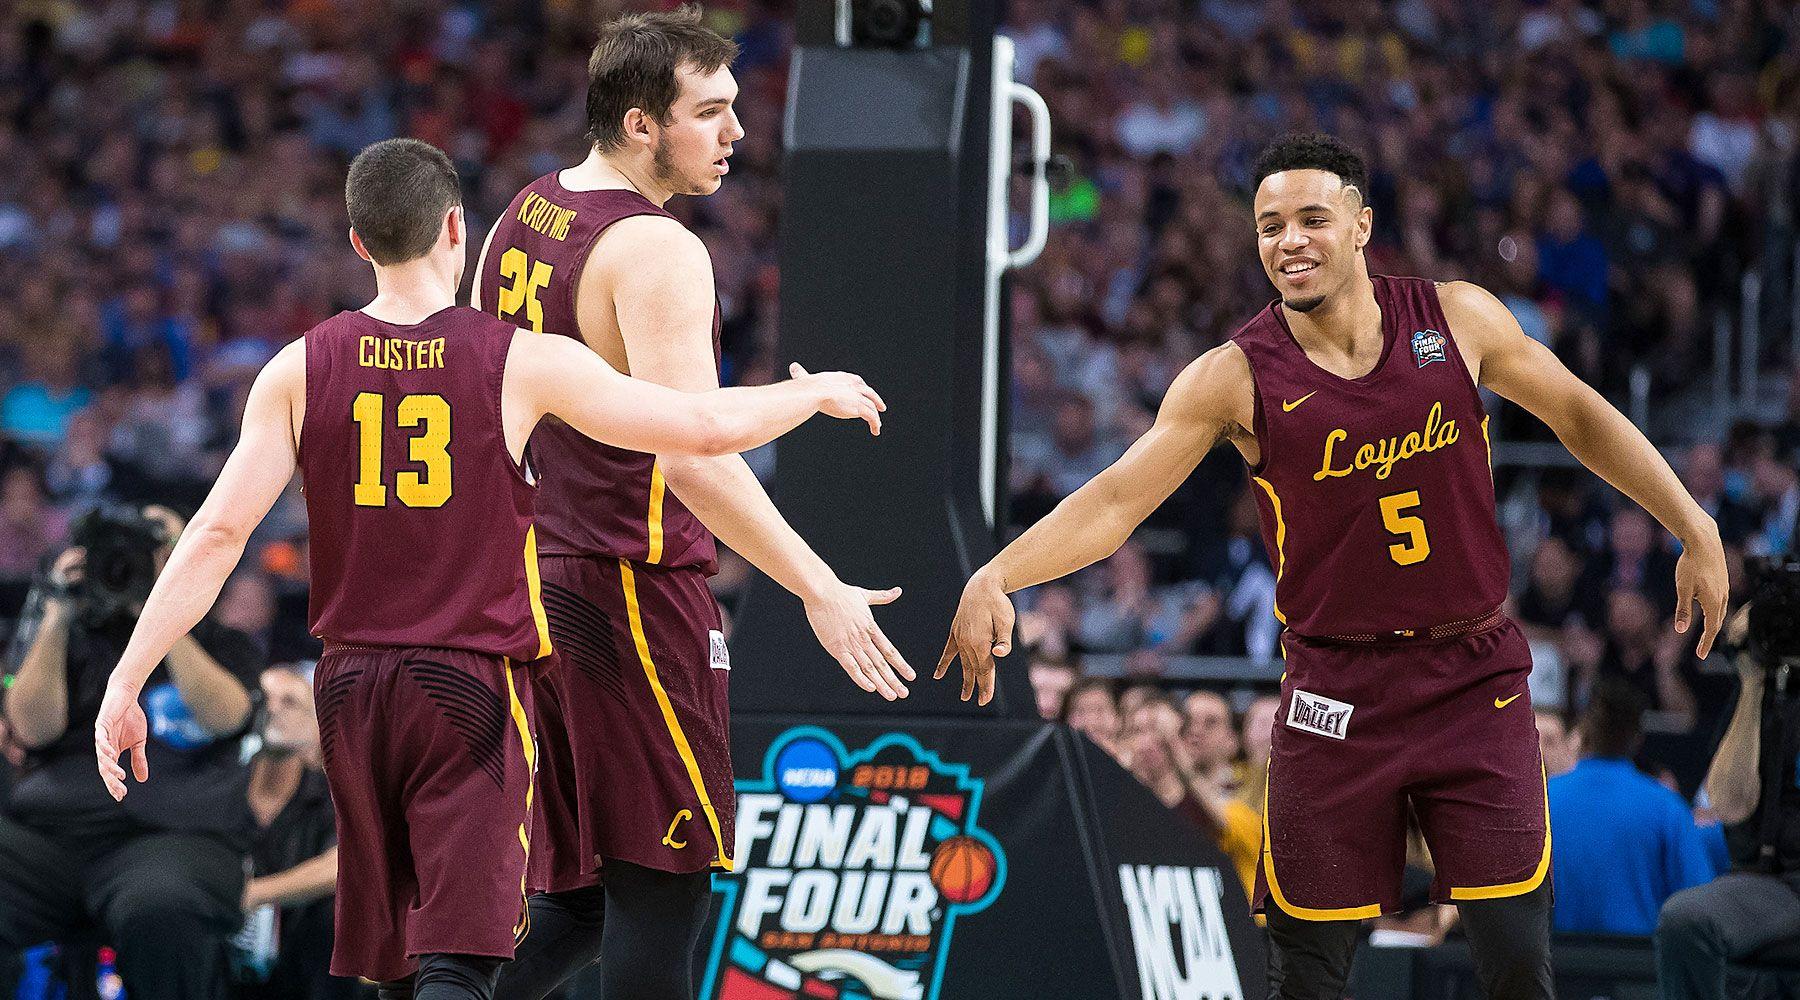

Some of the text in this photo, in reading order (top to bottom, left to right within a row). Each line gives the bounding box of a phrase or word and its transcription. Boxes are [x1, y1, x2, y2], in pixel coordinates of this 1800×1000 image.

[516, 190, 578, 242] KRUTWIG
[497, 246, 554, 334] 25
[358, 335, 446, 371] CUSTER
[1414, 335, 1437, 350] FINAL
[1418, 342, 1440, 356] FOUR
[352, 391, 453, 508] 13
[1313, 401, 1460, 482] Loyola
[1378, 489, 1432, 566] 5
[1292, 694, 1350, 736] VALLEY
[853, 764, 930, 790] 2018
[661, 808, 693, 849] L
[733, 793, 934, 875] FINAL
[736, 867, 940, 941] FOUR
[1117, 863, 1245, 1000] NCAA
